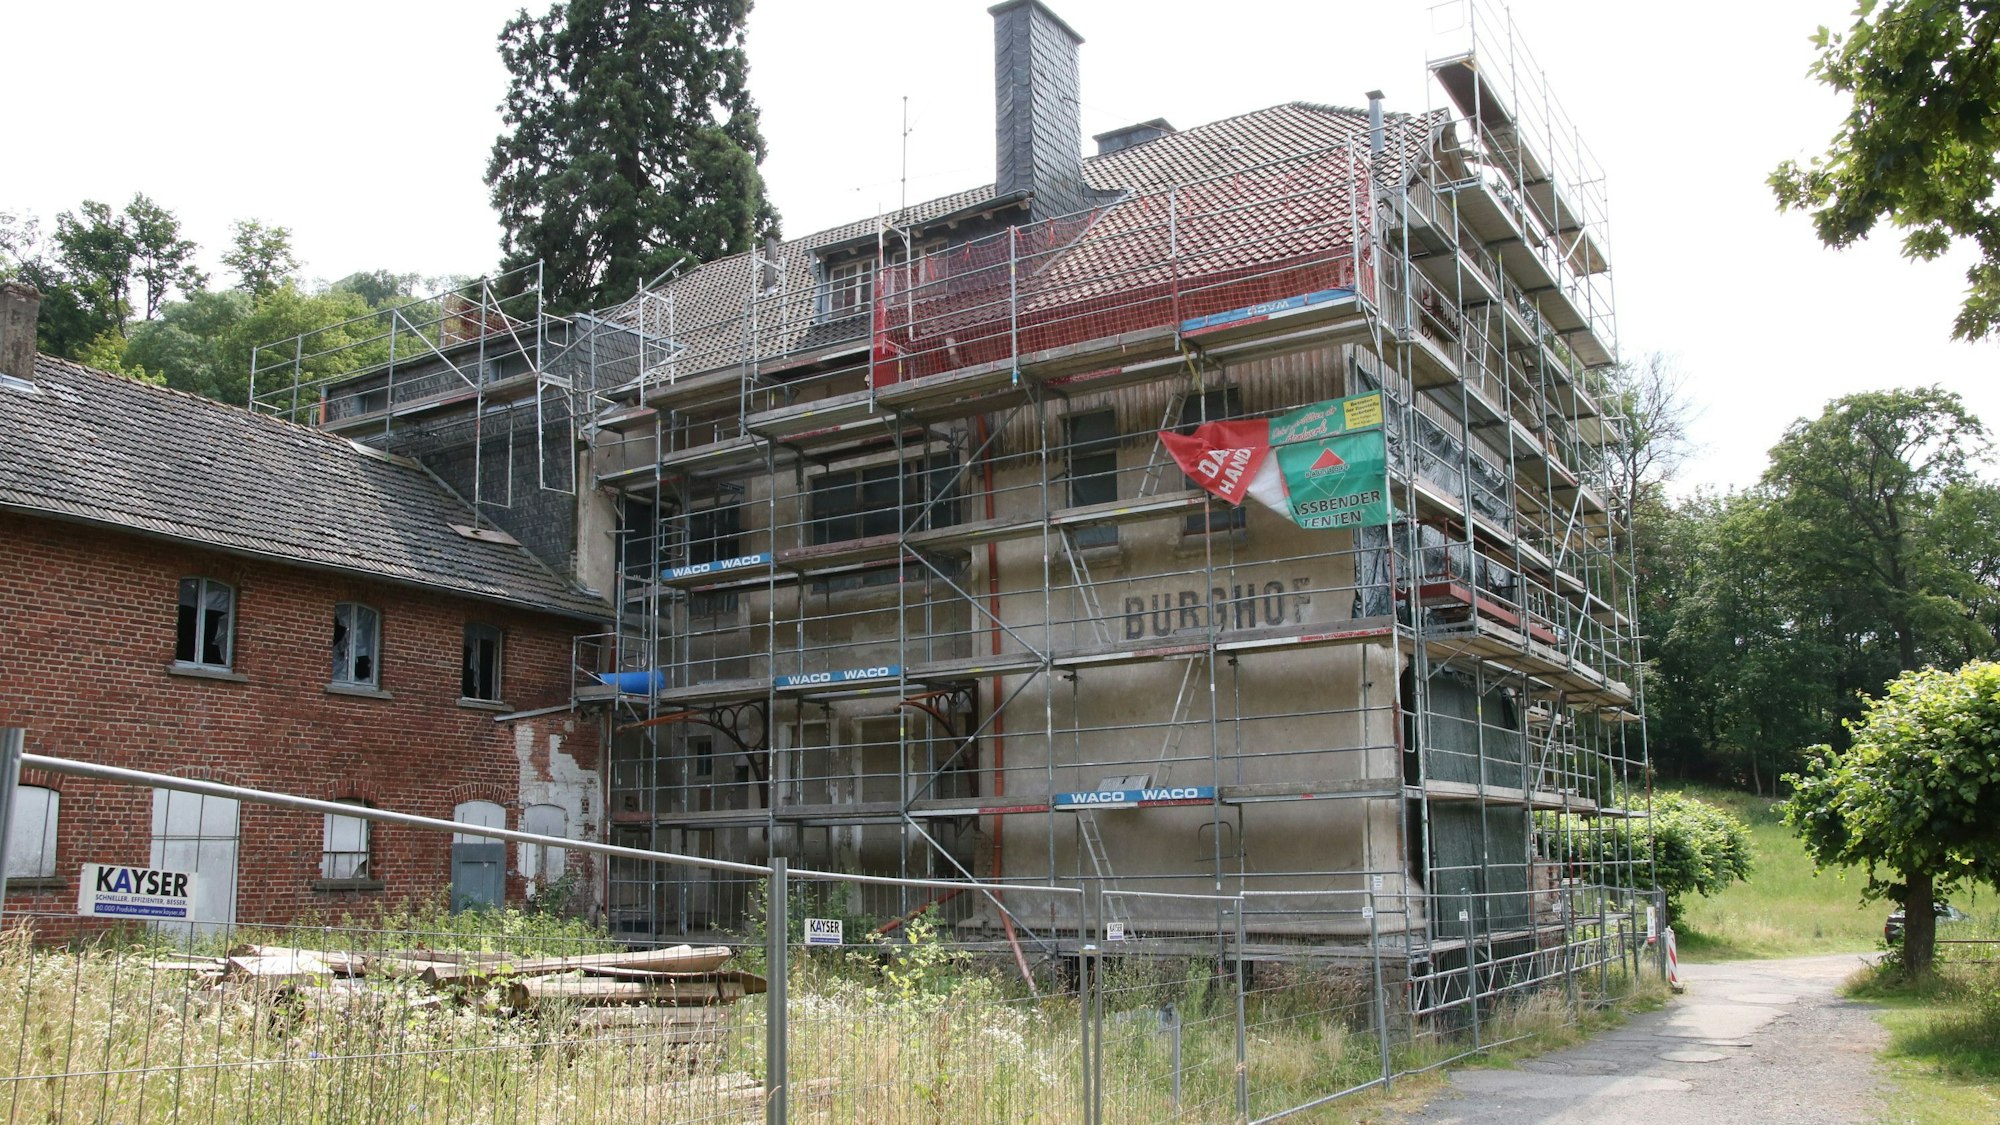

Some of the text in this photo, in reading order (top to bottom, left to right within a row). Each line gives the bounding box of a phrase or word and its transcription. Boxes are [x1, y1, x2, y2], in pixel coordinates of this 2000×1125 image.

[1198, 448, 1236, 479] DA
[1219, 447, 1256, 495] HAND
[672, 555, 760, 577] WACO WACO
[1125, 577, 1311, 640] BURGHOF
[788, 667, 889, 685] WACO WACO
[1071, 788, 1198, 804] WACO WACO
[97, 866, 188, 897] KAYSER
[95, 894, 129, 902] SCHNELLER.
[95, 903, 116, 912] 60.000
[116, 904, 138, 914] Produkte
[151, 908, 186, 917] www.kayser.de
[810, 920, 840, 933] KAYSER
